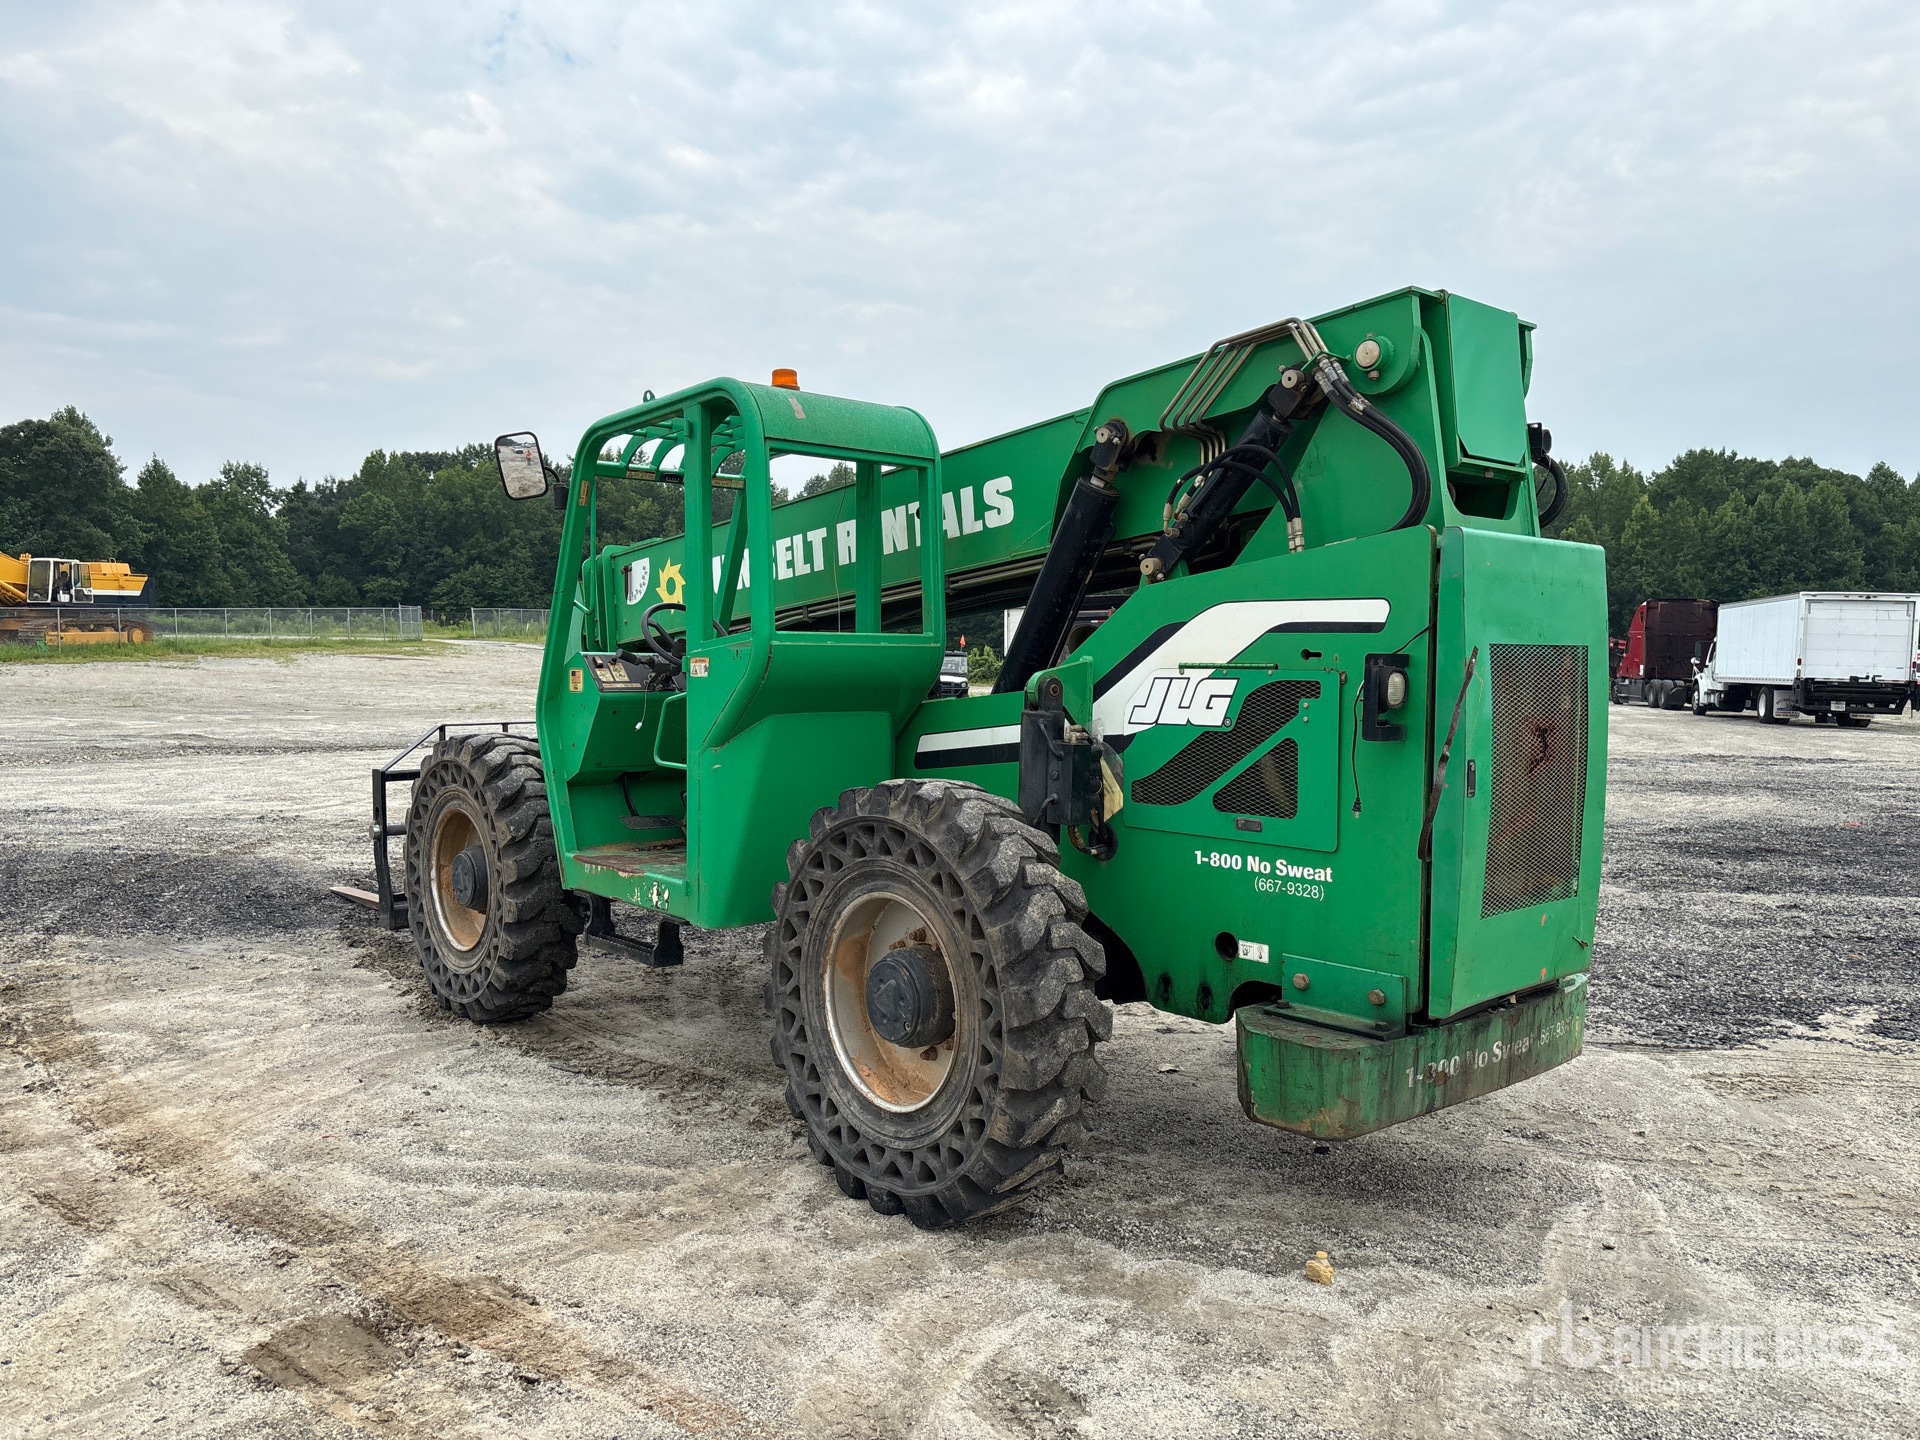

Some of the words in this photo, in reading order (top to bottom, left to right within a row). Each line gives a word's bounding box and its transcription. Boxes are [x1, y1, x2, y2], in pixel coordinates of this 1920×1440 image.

[837, 476, 1014, 566] RNTALS
[1128, 677, 1240, 727] JLG
[1195, 851, 1242, 870] 1-800
[1247, 855, 1271, 874] No
[1275, 859, 1333, 882] Sweat
[1255, 876, 1324, 901] (667-9328)
